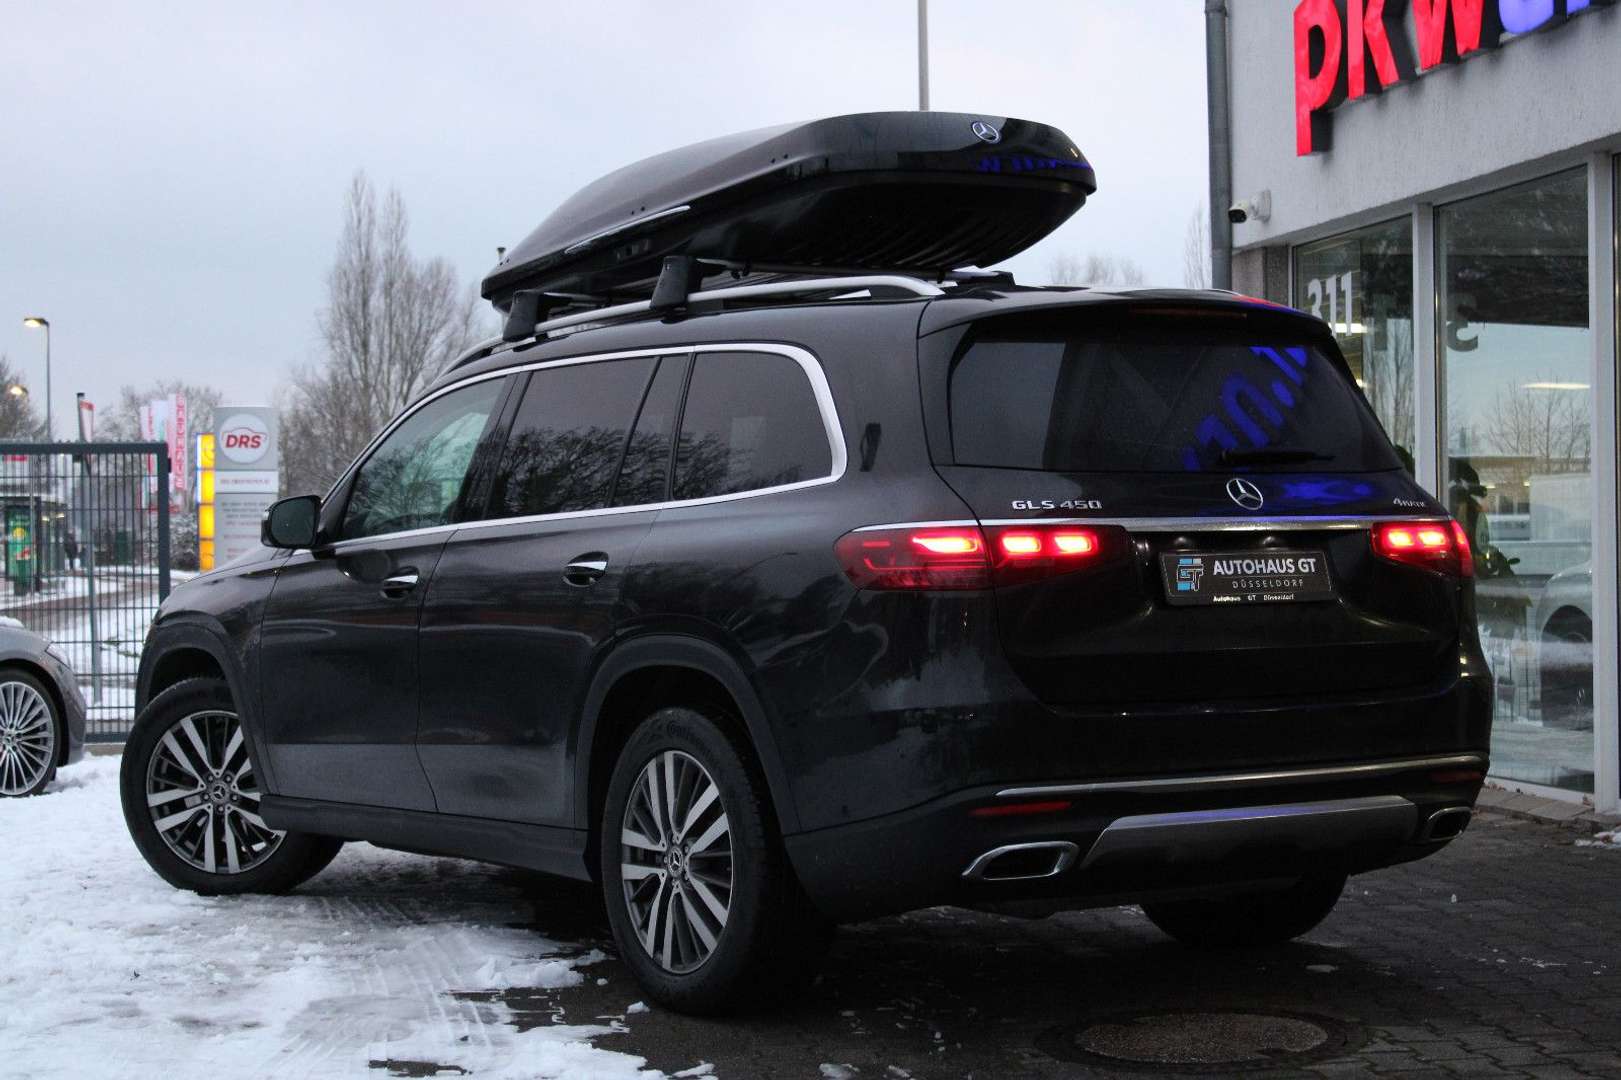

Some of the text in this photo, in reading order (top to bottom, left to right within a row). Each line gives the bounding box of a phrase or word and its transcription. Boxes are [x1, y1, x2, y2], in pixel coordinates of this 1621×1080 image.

[225, 434, 262, 449] DRS
[1012, 500, 1102, 510] GLS 450
[1213, 558, 1316, 575] AUTOHAUS GT
[1232, 578, 1304, 589] DÜSSELDORF
